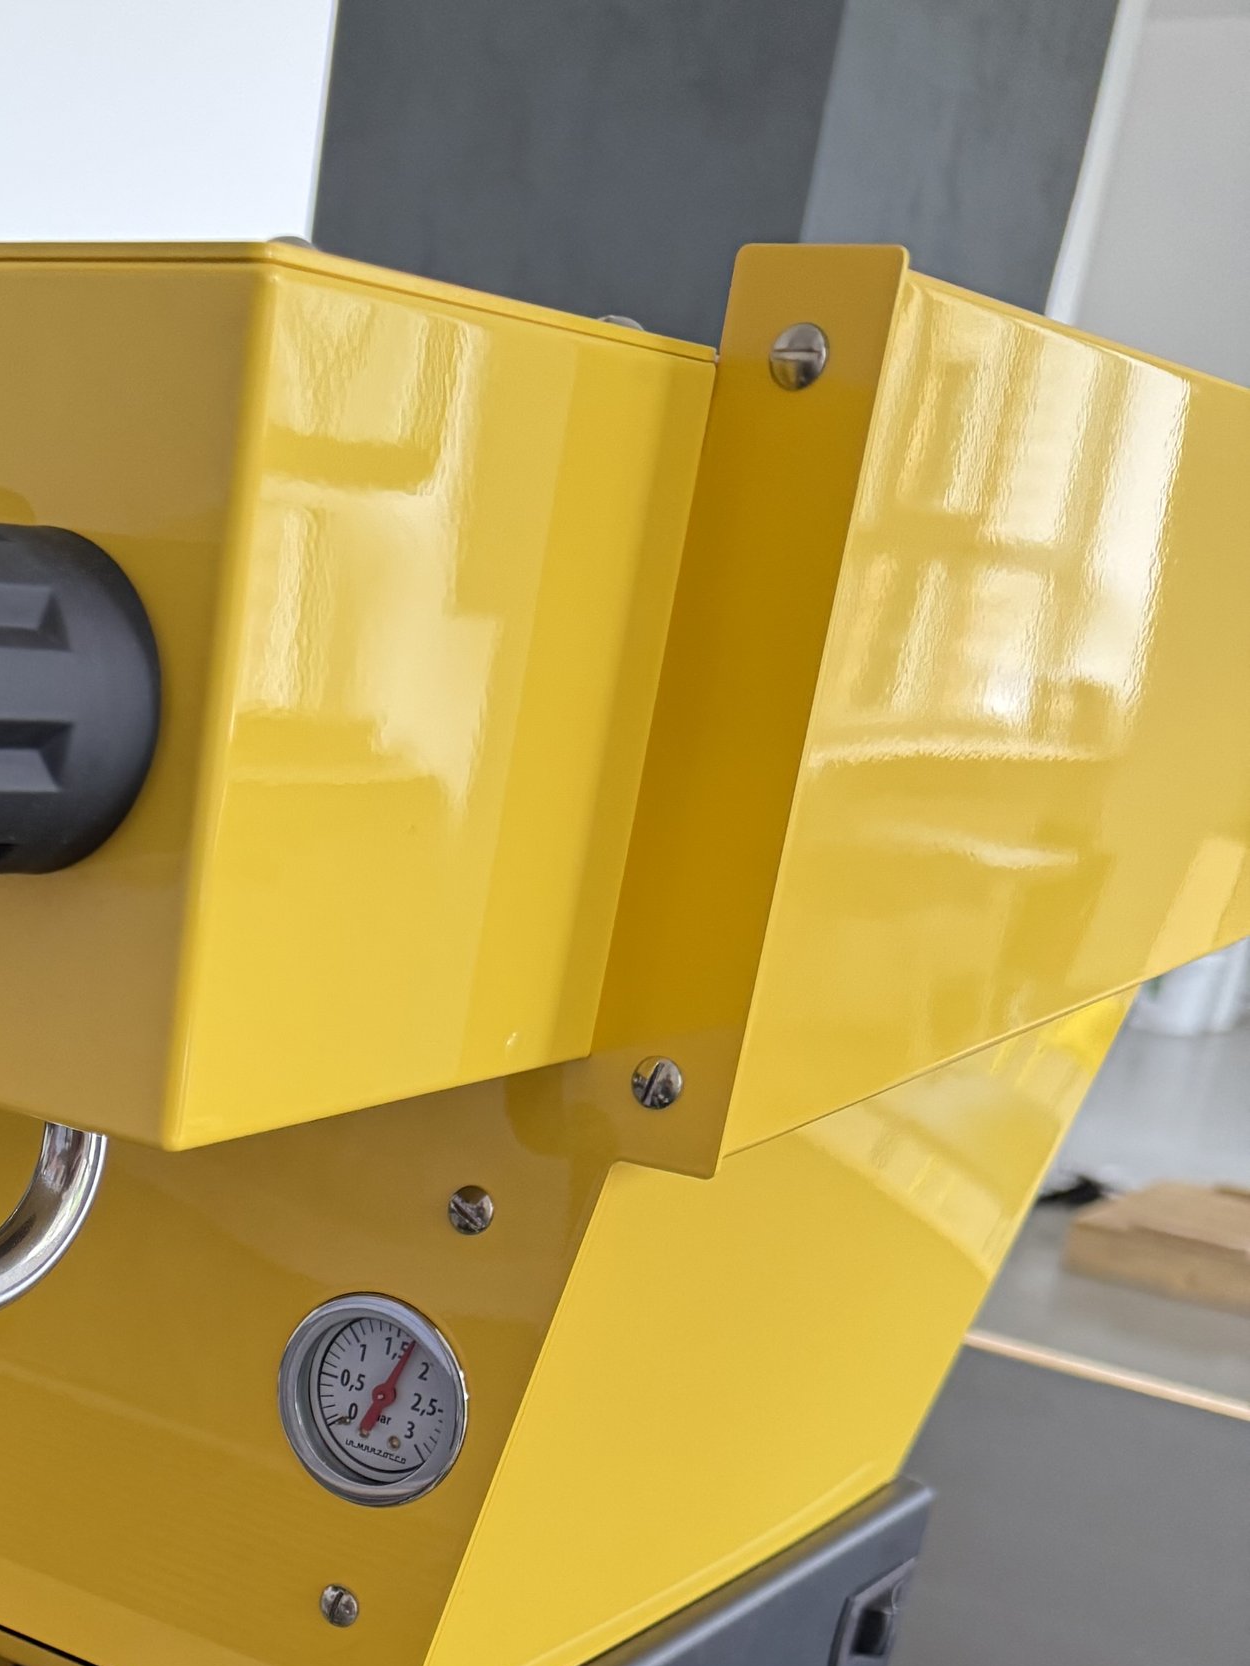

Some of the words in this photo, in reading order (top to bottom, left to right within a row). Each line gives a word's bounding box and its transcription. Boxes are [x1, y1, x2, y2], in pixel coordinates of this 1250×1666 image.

[359, 1344, 367, 1362] 1
[340, 1369, 366, 1391] 0,5
[417, 1362, 429, 1381] 2
[348, 1403, 358, 1420] 0
[411, 1392, 438, 1416] 2,5
[404, 1421, 415, 1439] 3
